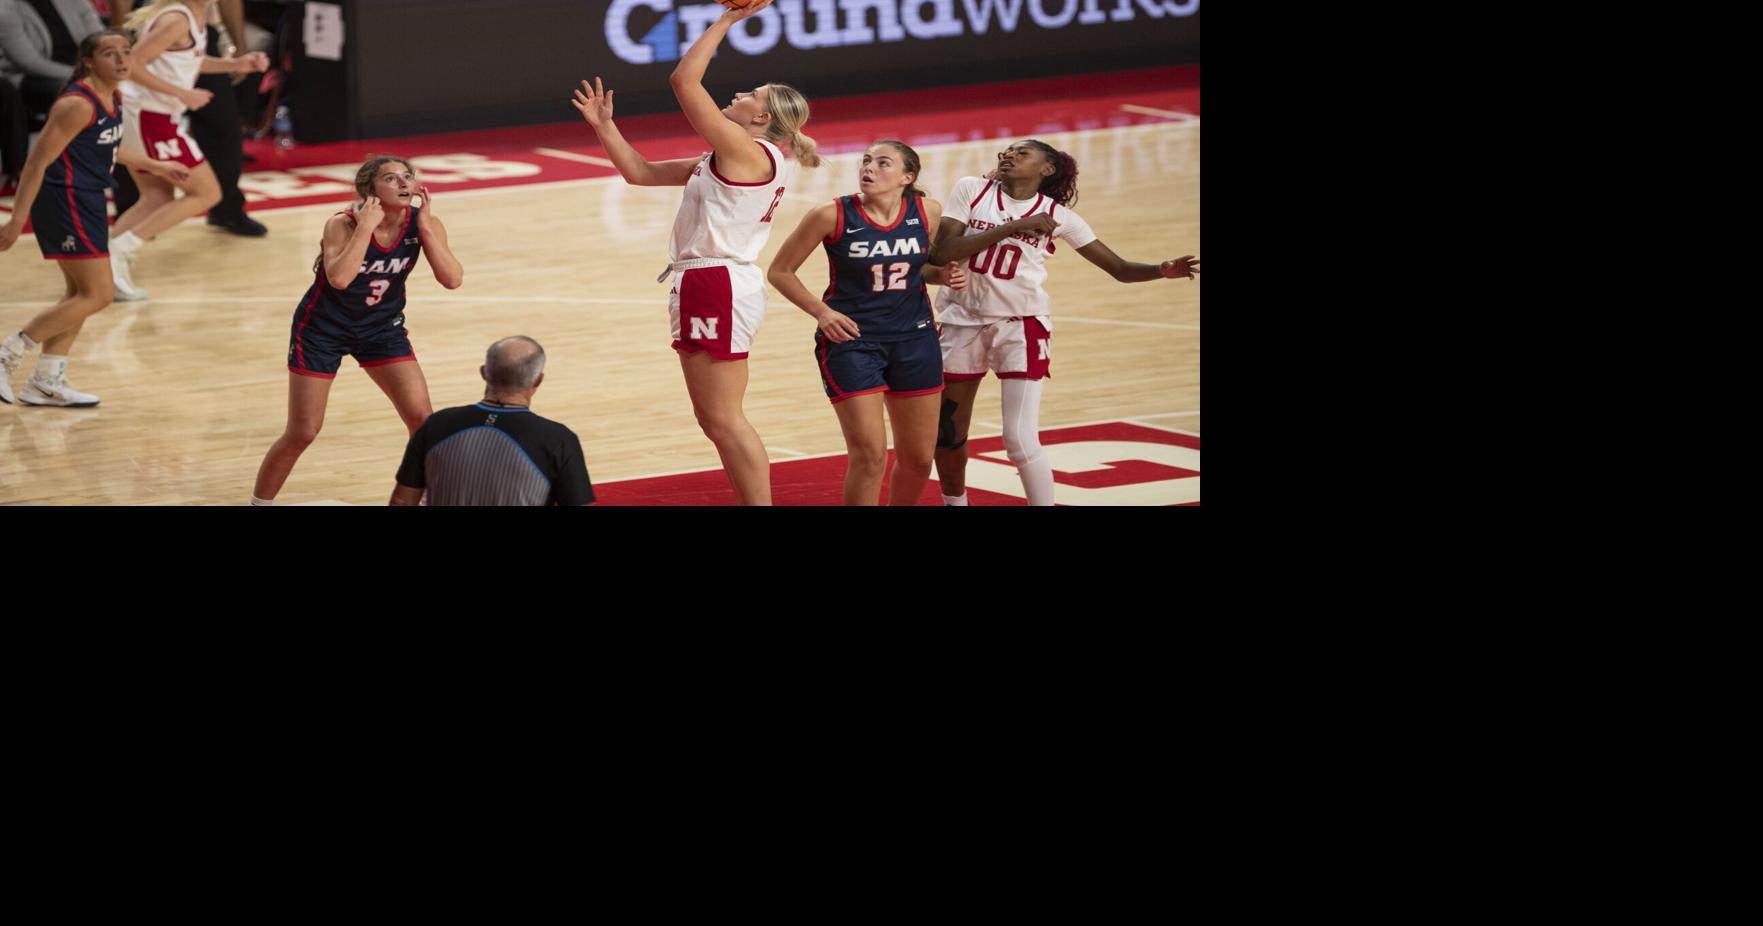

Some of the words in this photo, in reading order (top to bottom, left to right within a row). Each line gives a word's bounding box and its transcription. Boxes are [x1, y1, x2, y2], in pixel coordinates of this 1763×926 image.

[154, 138, 183, 160] N
[870, 261, 911, 292] 12
[968, 242, 1023, 281] 00
[364, 279, 391, 309] 3
[691, 317, 719, 339] N
